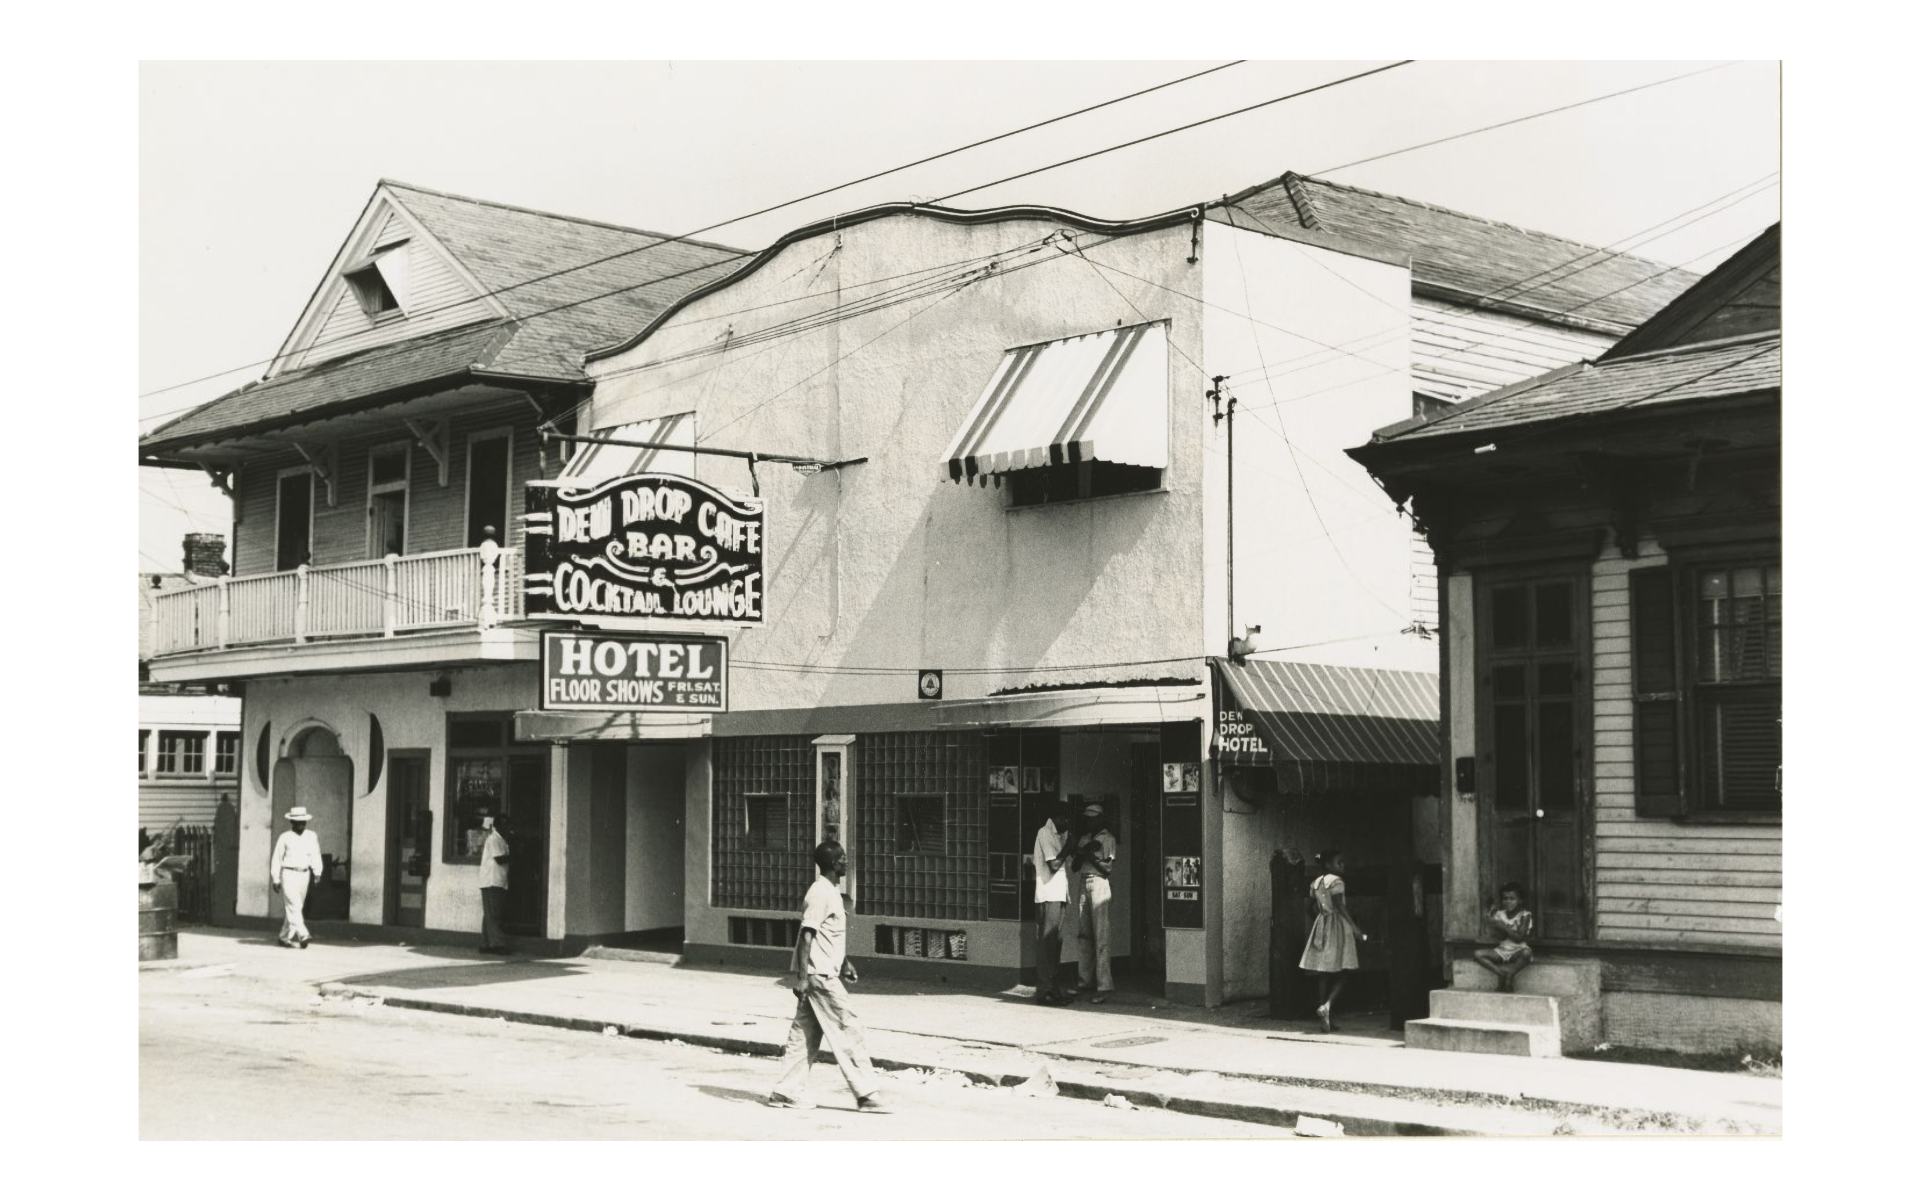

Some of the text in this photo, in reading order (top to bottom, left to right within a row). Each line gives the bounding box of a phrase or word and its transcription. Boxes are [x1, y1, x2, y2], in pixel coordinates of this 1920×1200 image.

[557, 487, 761, 554] DEW DROP CAFE
[626, 531, 696, 562] BAR
[554, 562, 761, 618] COCKTAIL LOUNGE
[651, 567, 675, 588] &
[559, 639, 713, 679] HOTEL
[550, 678, 601, 702] FLOOR
[606, 680, 664, 703] SHOWS
[676, 693, 719, 704] & SUN.
[1219, 723, 1254, 736] DROP
[1218, 736, 1268, 752] HOTEL
